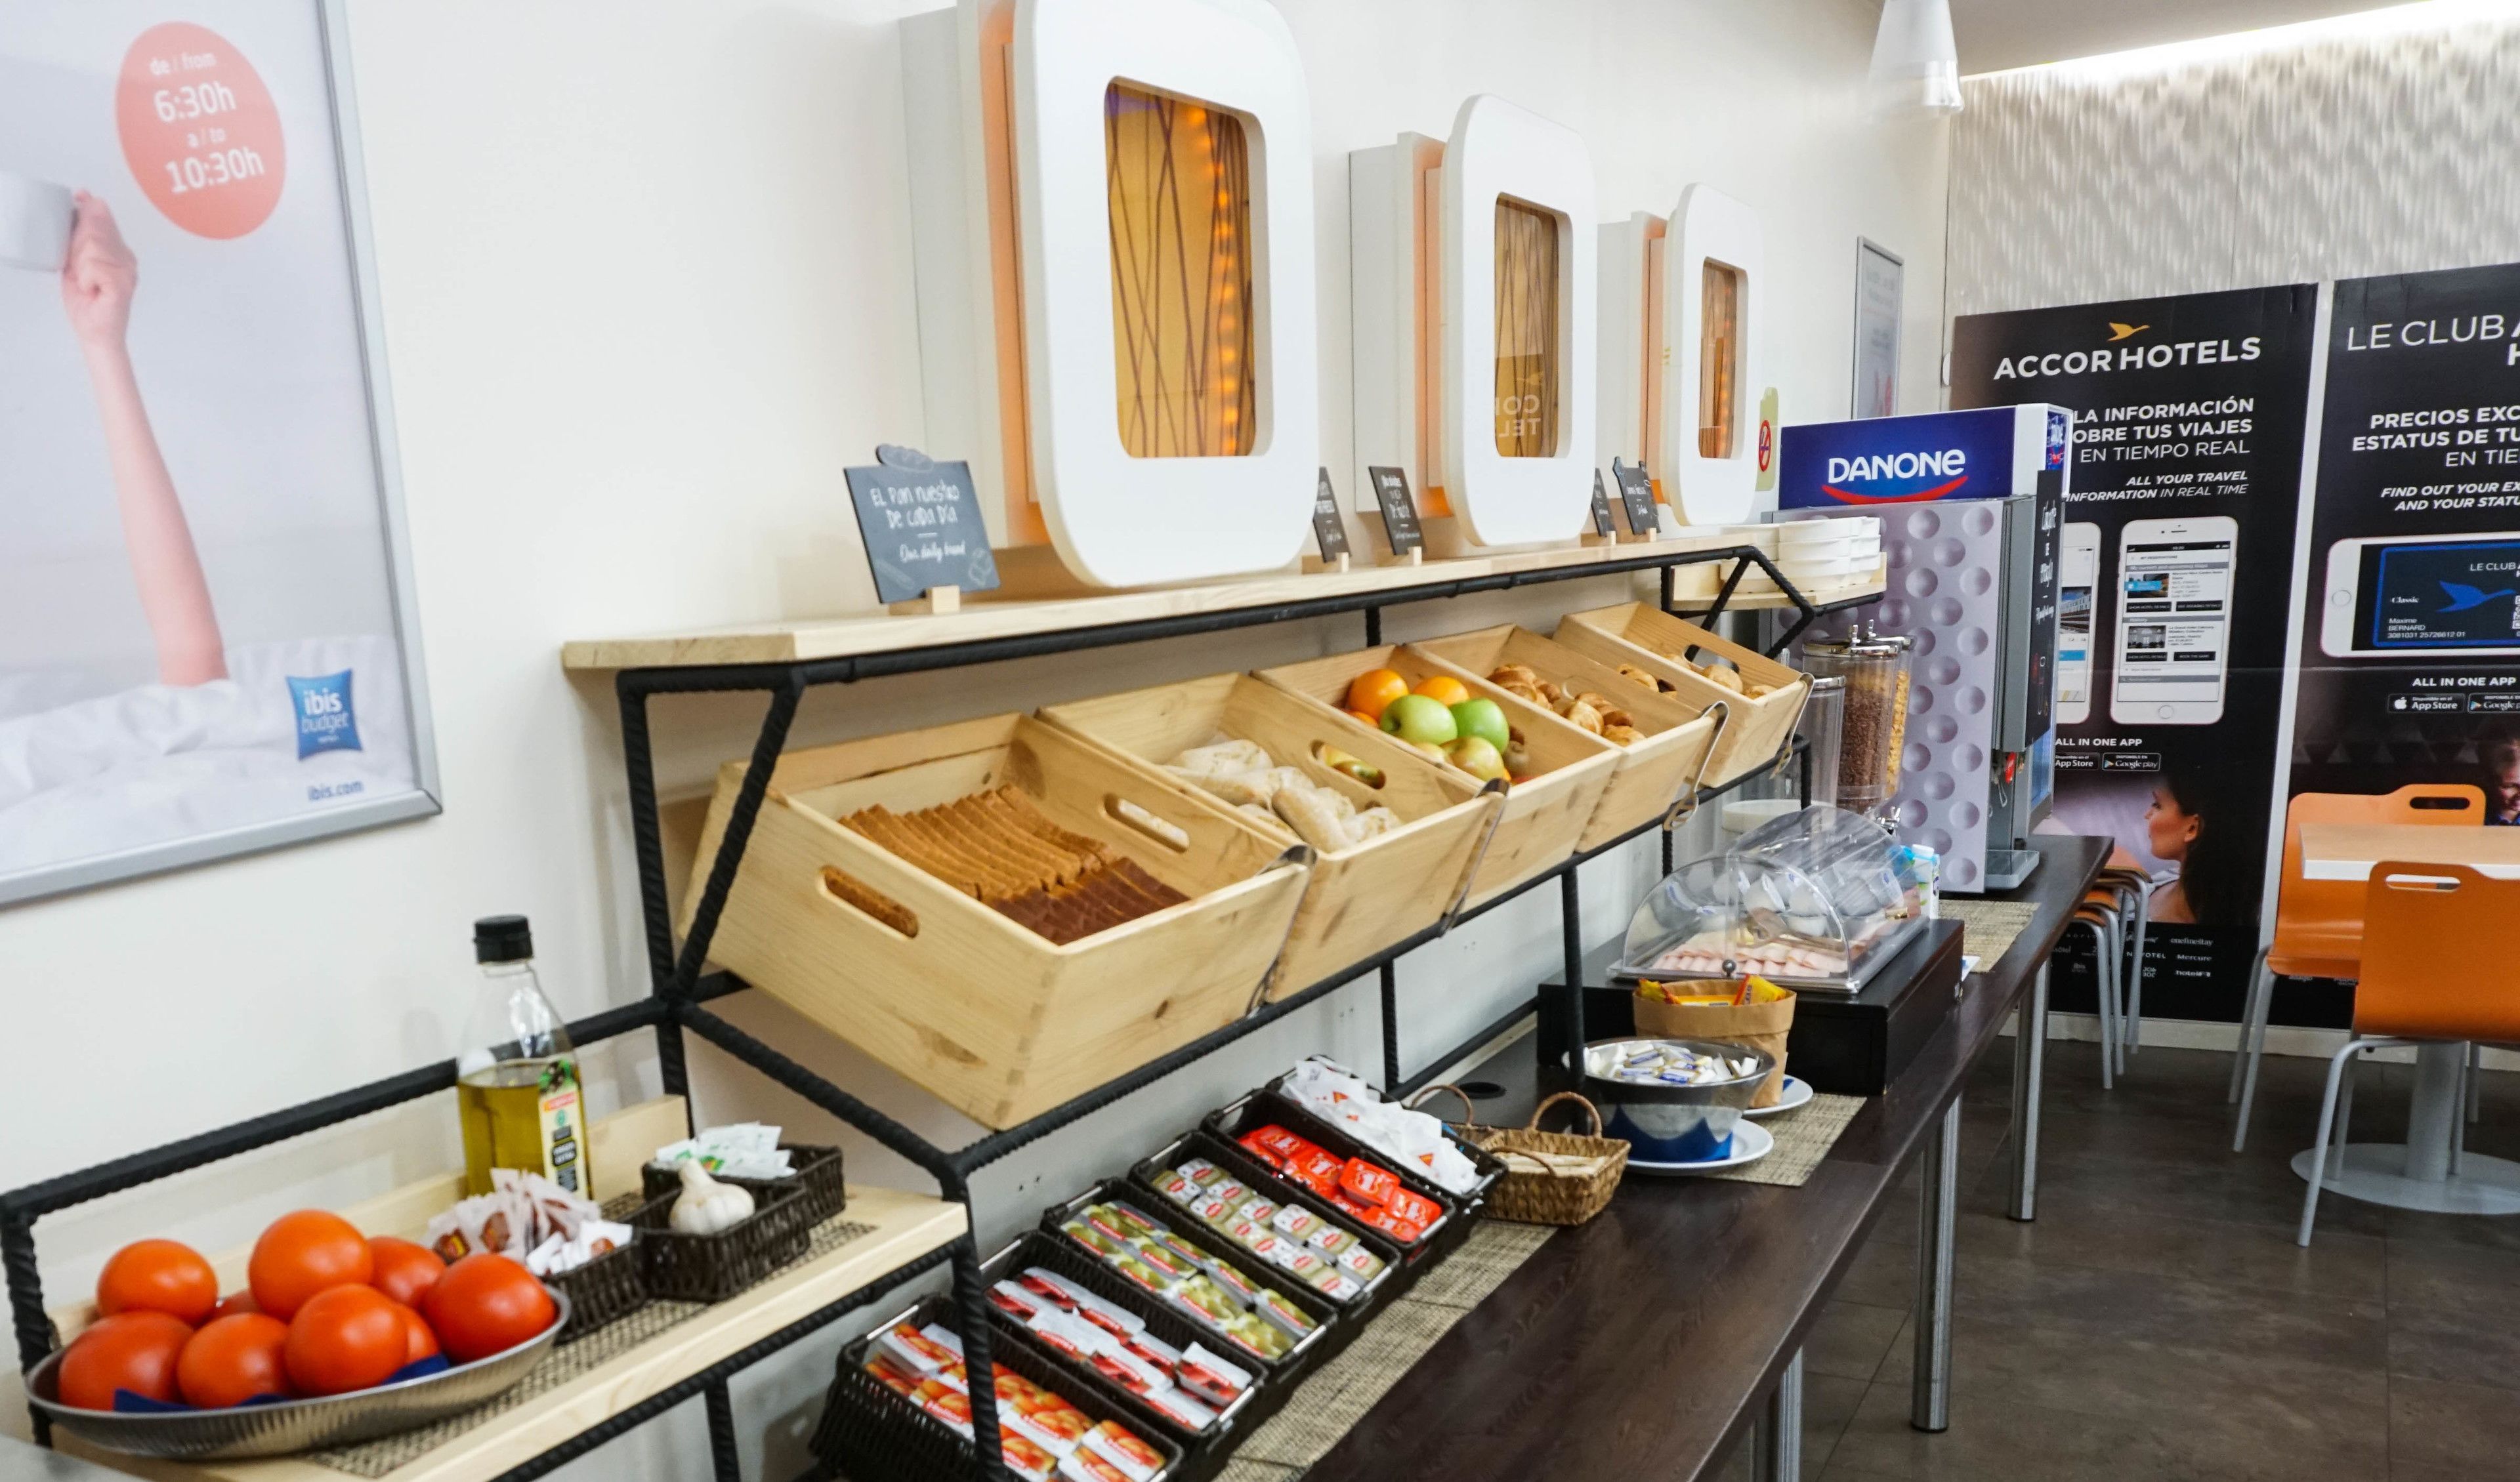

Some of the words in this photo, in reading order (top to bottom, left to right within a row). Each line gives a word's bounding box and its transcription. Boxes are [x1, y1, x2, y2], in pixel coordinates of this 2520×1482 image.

[149, 57, 170, 76] de
[181, 51, 217, 70] from
[154, 81, 237, 123] 6:30h
[188, 133, 199, 148] a
[209, 127, 226, 142] to
[165, 146, 266, 194] 10:30h
[2347, 323, 2393, 352] LE
[2401, 314, 2505, 347] CLUB
[1993, 350, 2111, 381] ACCOR
[2120, 336, 2261, 371] HOTELS
[2073, 407, 2099, 424] LA
[2105, 394, 2255, 422] INFORMACIÓN
[2370, 408, 2469, 430] PRECIOS
[2072, 424, 2127, 444] OBRE
[2133, 423, 2173, 440] TUS
[2178, 418, 2253, 438] VIAJES
[2352, 431, 2450, 452] ESTATUS
[2457, 428, 2488, 445] DE
[2080, 447, 2107, 463] EN
[2112, 443, 2189, 462] TIEMPO
[2195, 440, 2251, 457] REAL
[2445, 451, 2477, 468] EN
[2126, 475, 2153, 487] ALL
[2155, 473, 2194, 485] YOUR
[2197, 470, 2248, 483] TRAVEL
[2066, 488, 2157, 503] INFORMATION
[2160, 487, 2173, 499] IN
[2177, 485, 2214, 498] REAL
[2217, 484, 2248, 496] TIME
[2381, 485, 2418, 499] FIND
[2421, 484, 2454, 497] OUT
[2456, 482, 2499, 495] YOUR
[2395, 499, 2429, 512] AND
[2433, 497, 2476, 510] YOUR
[2485, 562, 2516, 571] CLUB
[2412, 678, 2437, 687] ALL
[2441, 678, 2454, 686] IN
[2458, 677, 2486, 686] ONE
[2489, 677, 2517, 686] APP
[303, 687, 344, 716] ibis
[2412, 702, 2432, 711] App
[2433, 701, 2458, 710] Store
[2483, 701, 2513, 711] Google
[2120, 738, 2143, 747] APP
[2115, 760, 2142, 769] Google
[307, 780, 364, 801] ibis.com
